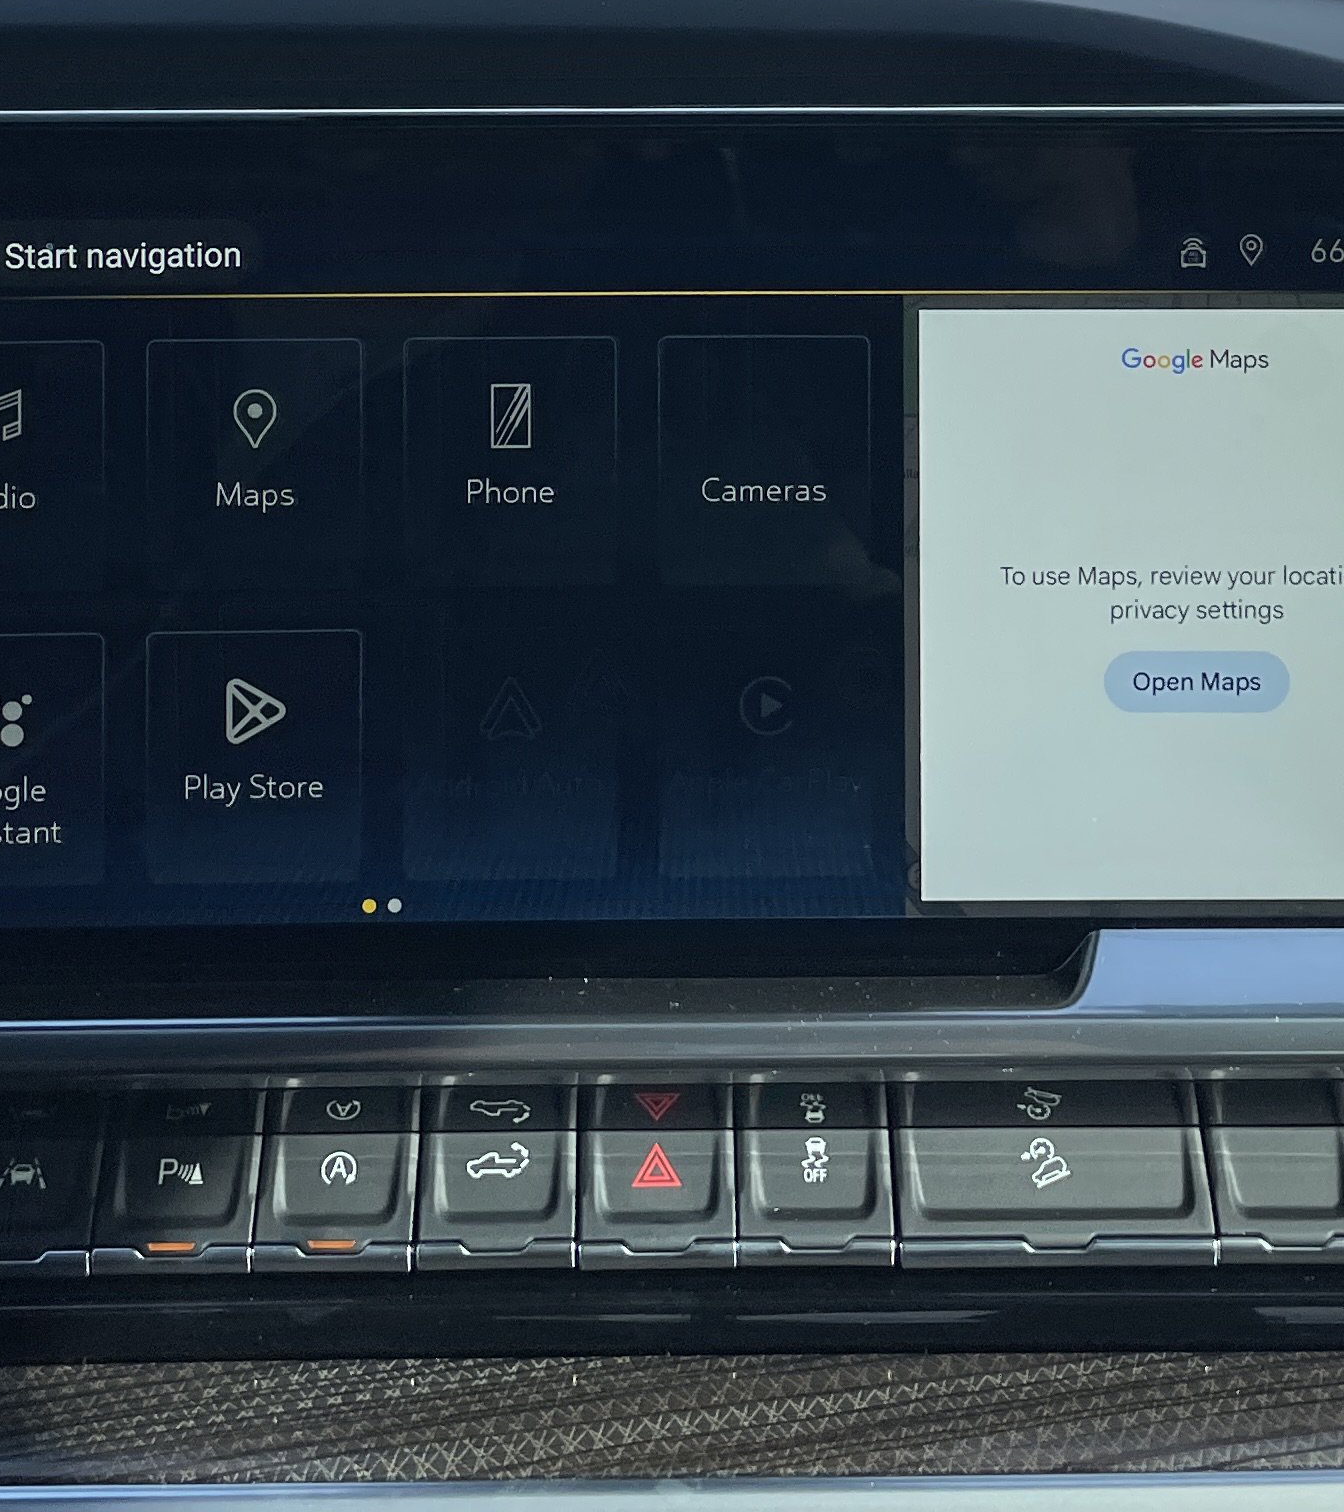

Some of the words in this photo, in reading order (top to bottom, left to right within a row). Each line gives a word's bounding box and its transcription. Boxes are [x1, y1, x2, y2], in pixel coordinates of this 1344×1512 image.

[6, 243, 77, 269] Start
[88, 242, 240, 274] navigation
[1122, 348, 1203, 374] Google
[1210, 348, 1269, 372] Maps
[216, 481, 295, 513] Maps
[466, 477, 555, 504] Phone
[701, 477, 827, 503] Cameras
[1000, 567, 1025, 585] To
[1032, 571, 1071, 585] use
[1078, 567, 1143, 590] Maps,
[1150, 565, 1222, 585] review
[1227, 571, 1275, 591] your
[1110, 599, 1190, 624] privacy
[1196, 598, 1284, 624] settings
[1133, 672, 1194, 697] Open
[1201, 671, 1261, 697] Maps
[185, 773, 241, 808] Play
[249, 773, 324, 799] Store
[158, 1158, 179, 1185] P
[328, 1155, 348, 1180] A
[803, 1168, 828, 1183] OFF
